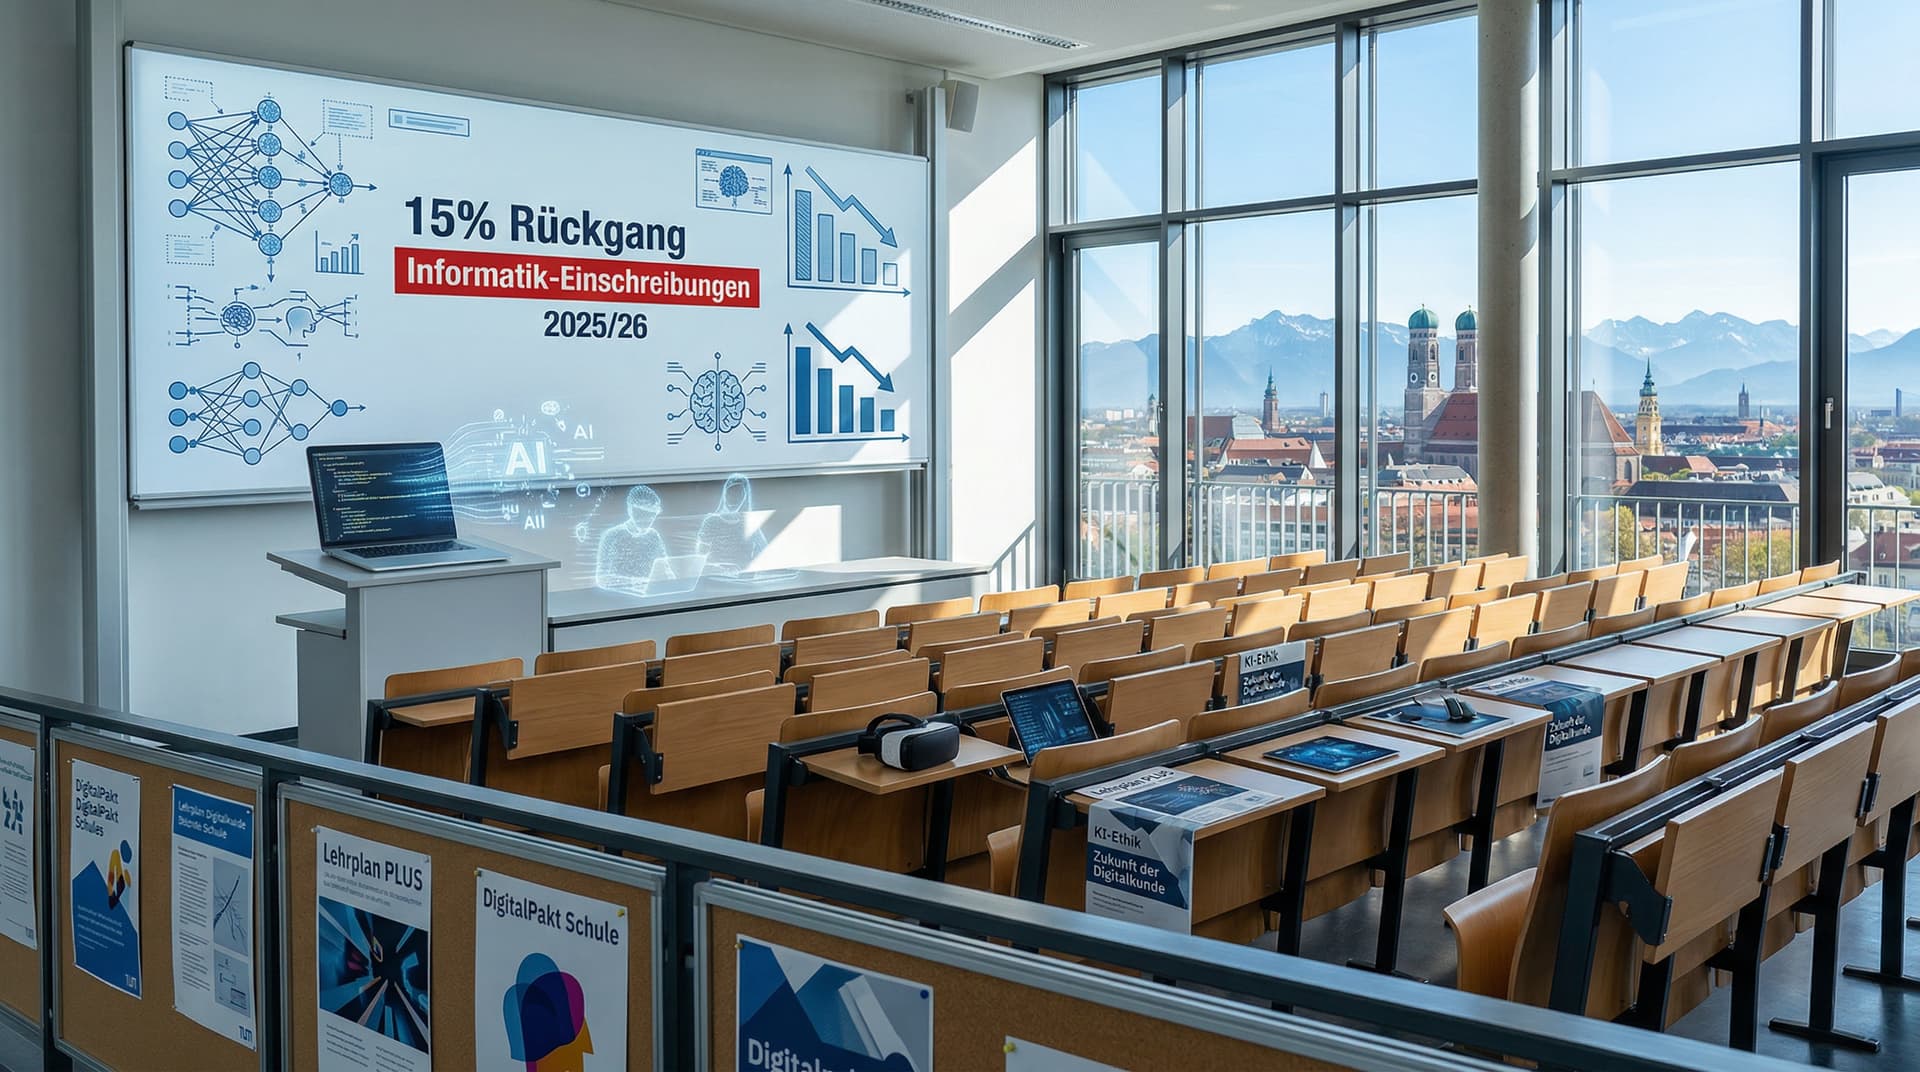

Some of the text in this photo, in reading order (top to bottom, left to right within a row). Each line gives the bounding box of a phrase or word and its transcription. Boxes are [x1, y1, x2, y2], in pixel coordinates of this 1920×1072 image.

[405, 195, 687, 260] 15% Rückgang
[407, 255, 751, 304] Informatik-Einschreibungen
[543, 310, 648, 339] 2025/26
[573, 423, 594, 441] AI
[503, 440, 547, 476] AI
[1244, 648, 1279, 668] KI-Ethik
[1094, 825, 1141, 850] KI-Ethik
[323, 842, 381, 880] Lehrplan
[385, 860, 423, 892] PLUS
[1093, 850, 1160, 878] Zukunft der
[1093, 864, 1166, 895] Digitalkunde
[483, 886, 620, 946] DigitalPakt Schule
